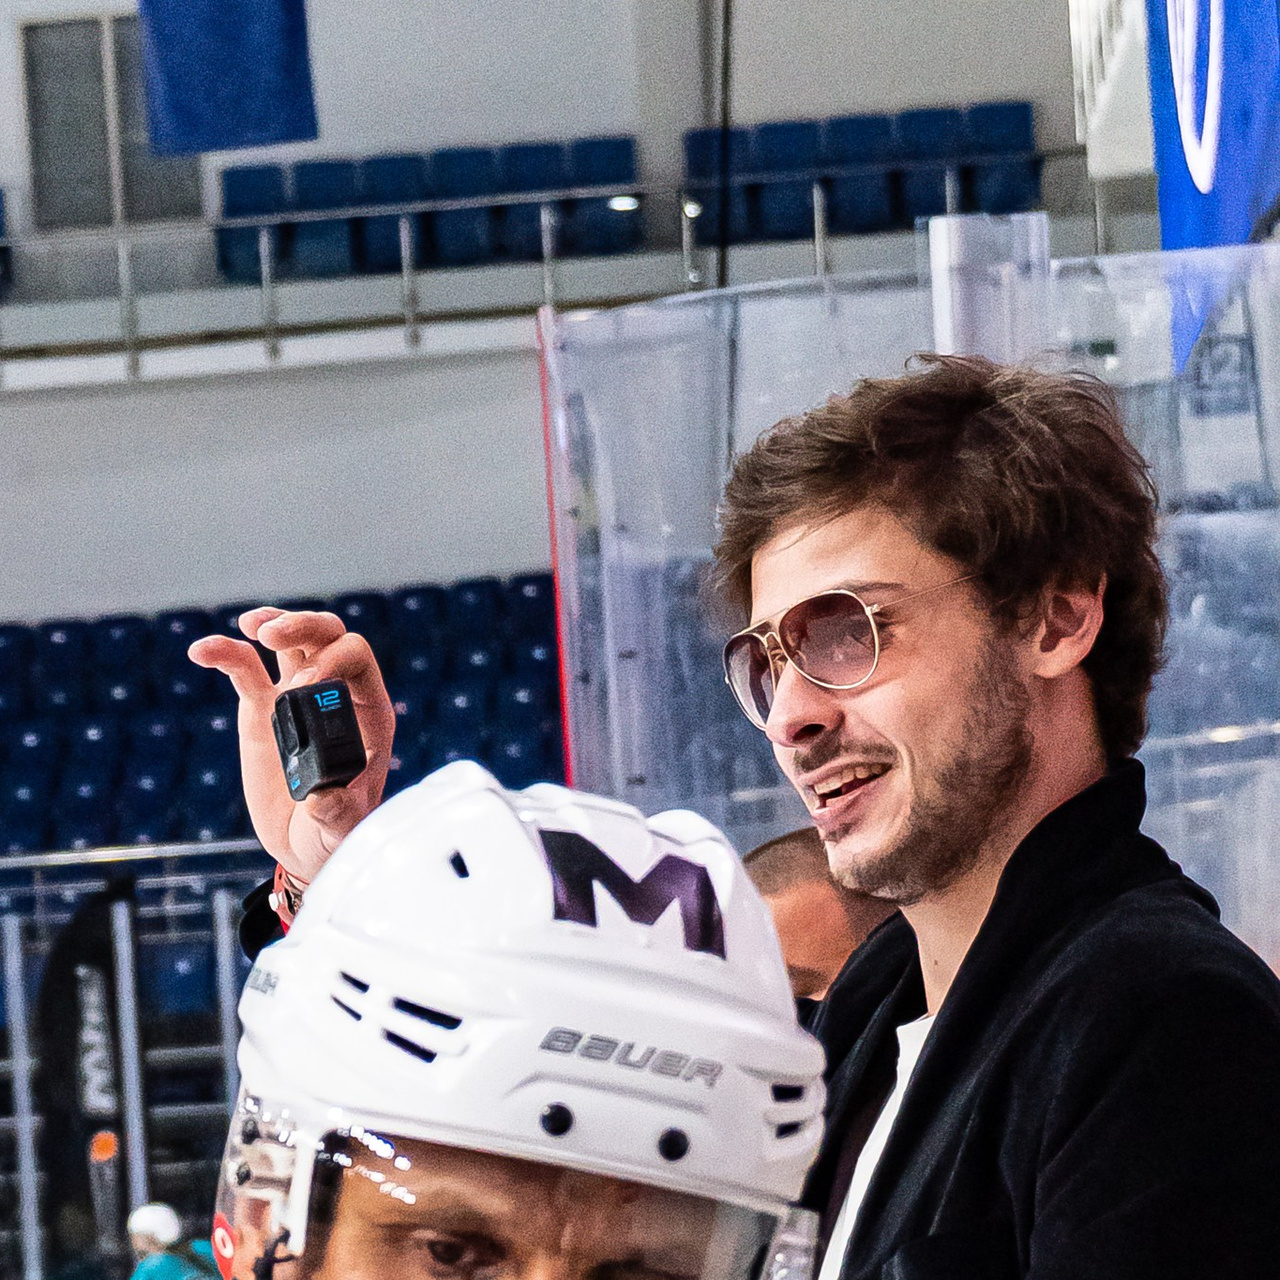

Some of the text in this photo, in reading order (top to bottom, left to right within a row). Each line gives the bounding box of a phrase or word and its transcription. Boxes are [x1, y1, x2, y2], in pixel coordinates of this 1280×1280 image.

[314, 689, 340, 707] 12
[537, 828, 727, 961] M
[538, 1022, 723, 1090] BAUER
